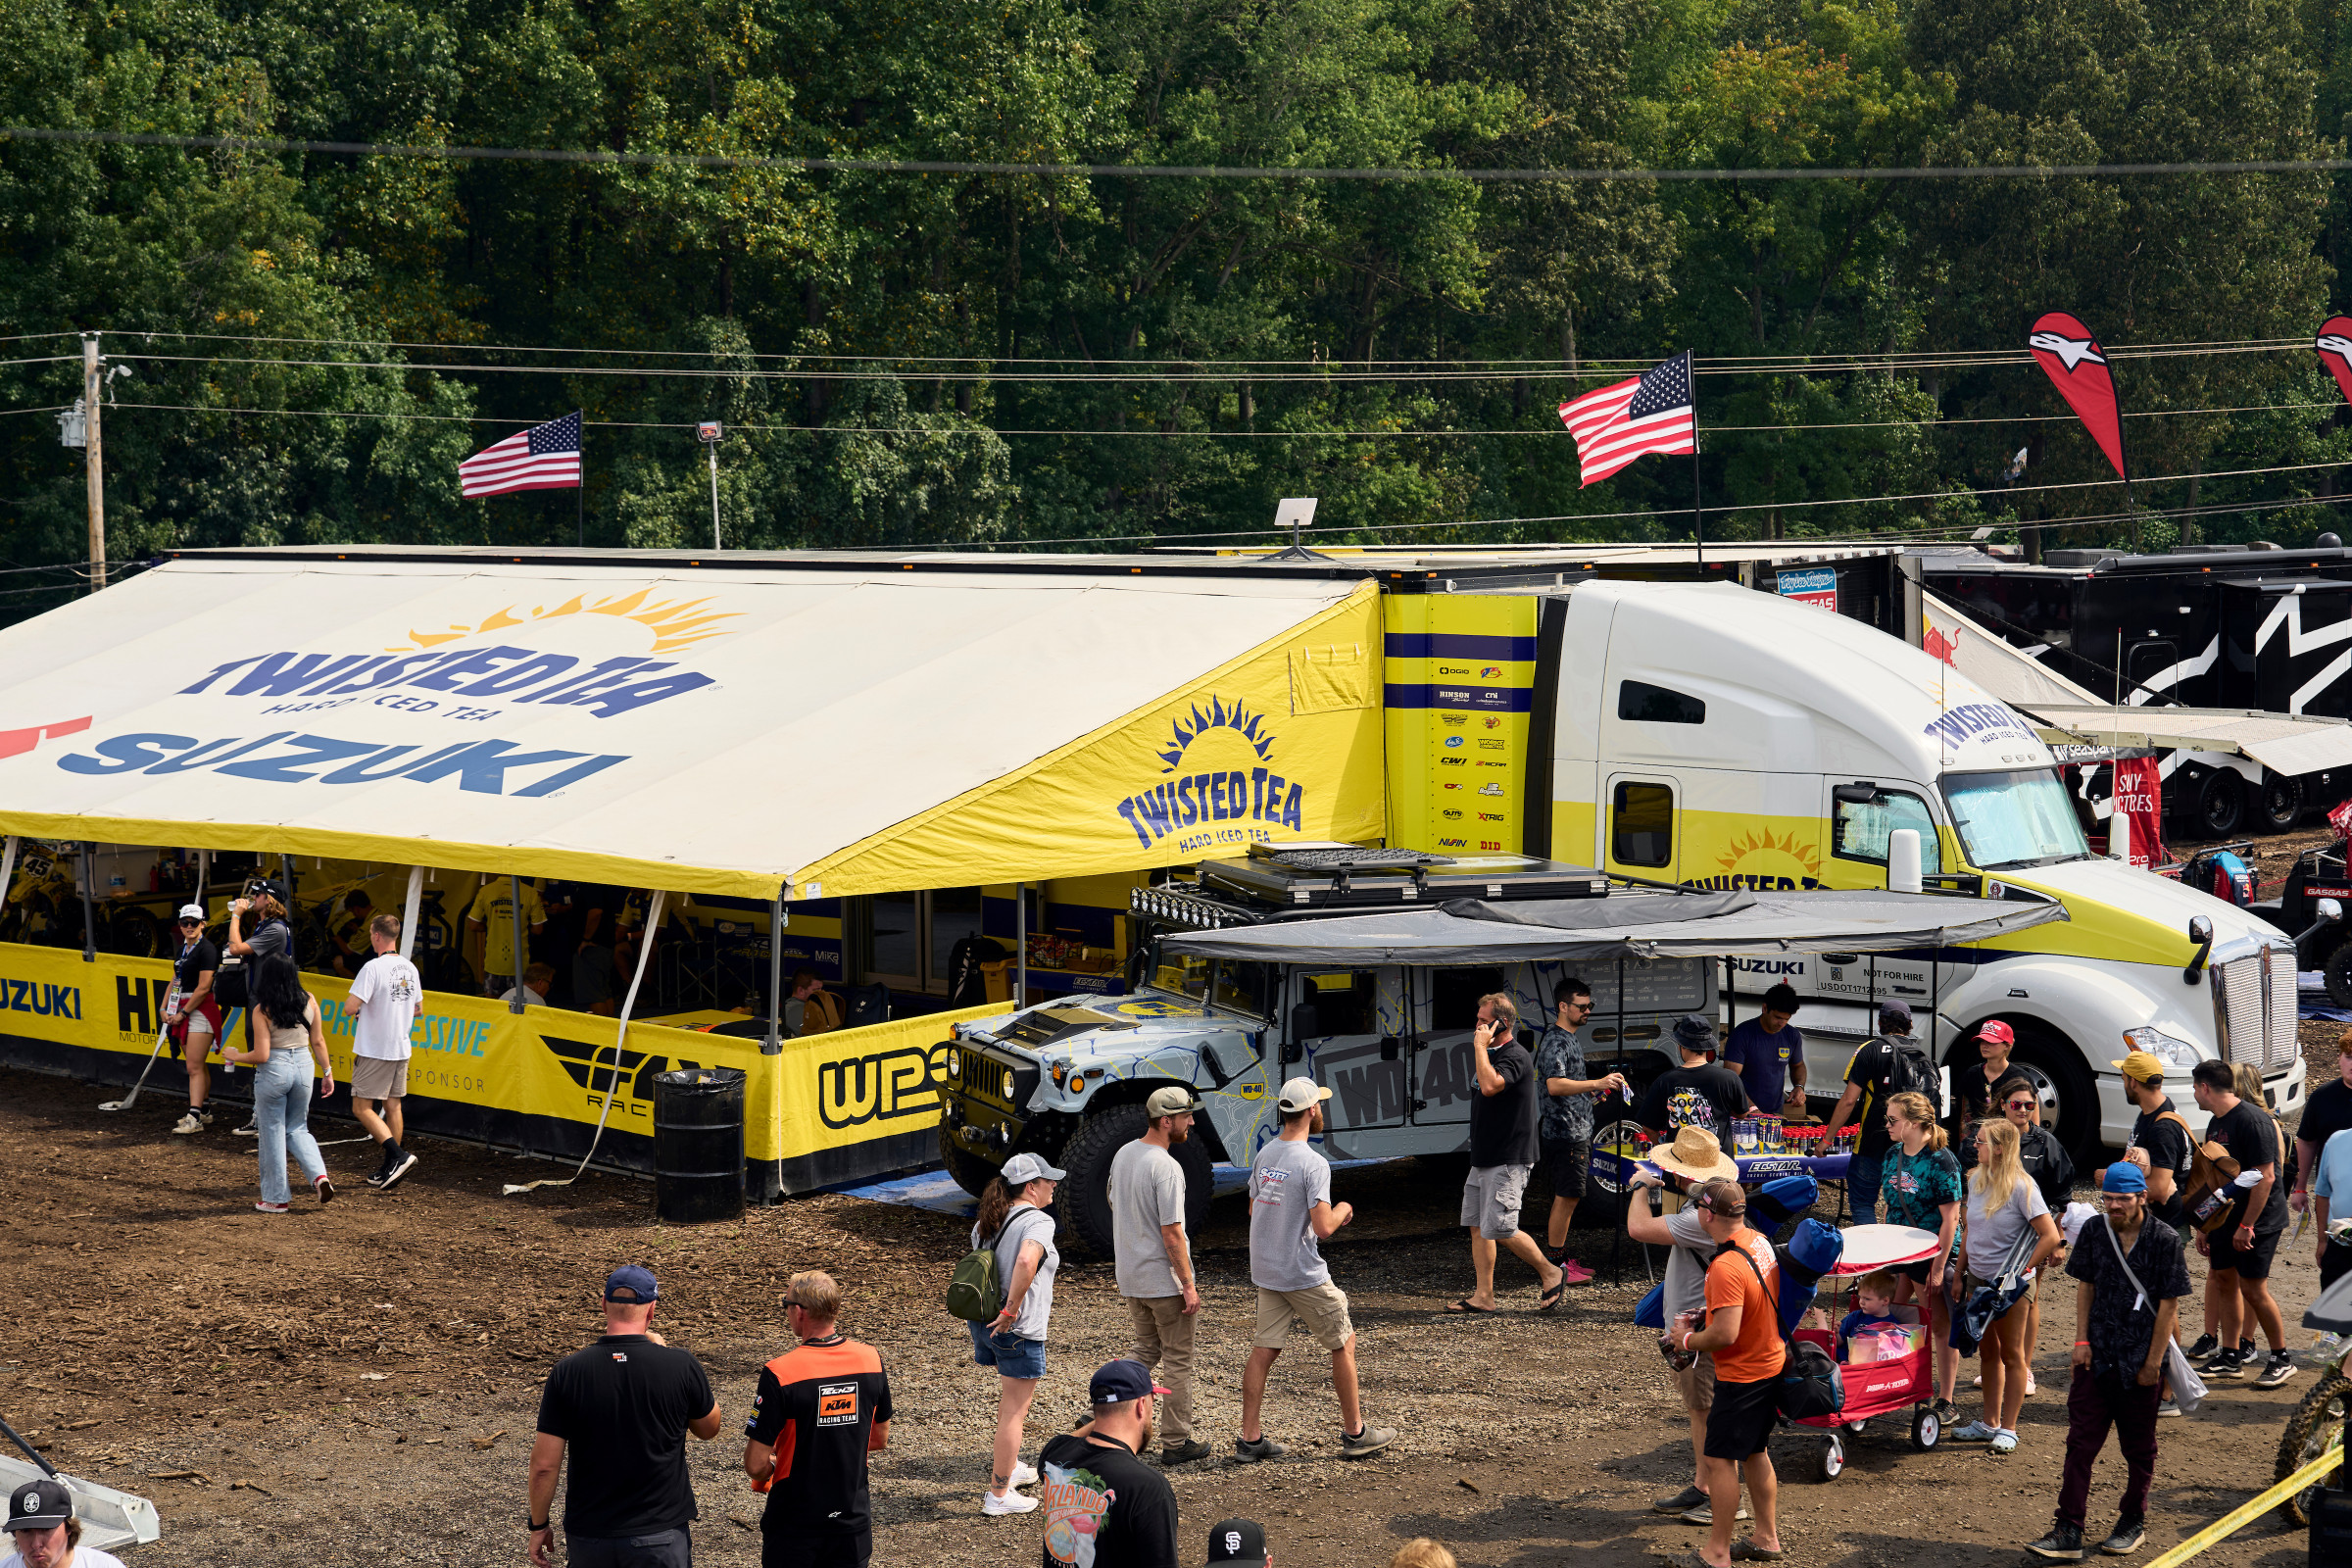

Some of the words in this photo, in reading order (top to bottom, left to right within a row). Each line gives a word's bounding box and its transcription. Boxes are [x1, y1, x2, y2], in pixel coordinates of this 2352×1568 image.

[176, 646, 579, 697] TWISTED
[512, 657, 715, 718] TEA
[261, 697, 355, 716] HARD
[360, 693, 439, 713] ICED
[441, 706, 503, 721] TEA
[57, 731, 632, 799] SUZUKI
[1116, 771, 1247, 851] TWISTED
[1250, 766, 1303, 832] TEA
[1478, 812, 1504, 821] XTRIG
[1179, 834, 1211, 855] HARD
[1215, 830, 1243, 845] ICED
[1248, 828, 1271, 843] TEA
[24, 858, 51, 875] 45
[2307, 888, 2350, 897] GASGAS
[1884, 971, 1901, 980] FOR
[1903, 972, 1924, 982] HIRE
[320, 999, 491, 1057] PRESSIVE
[407, 1069, 484, 1093] SPONSOR
[1335, 1042, 1476, 1127] WD-40
[1592, 1157, 1617, 1170] SUZUK
[1748, 1160, 1801, 1172] ECSTAR
[821, 1386, 856, 1396] TECH3
[825, 1399, 852, 1411] KTM
